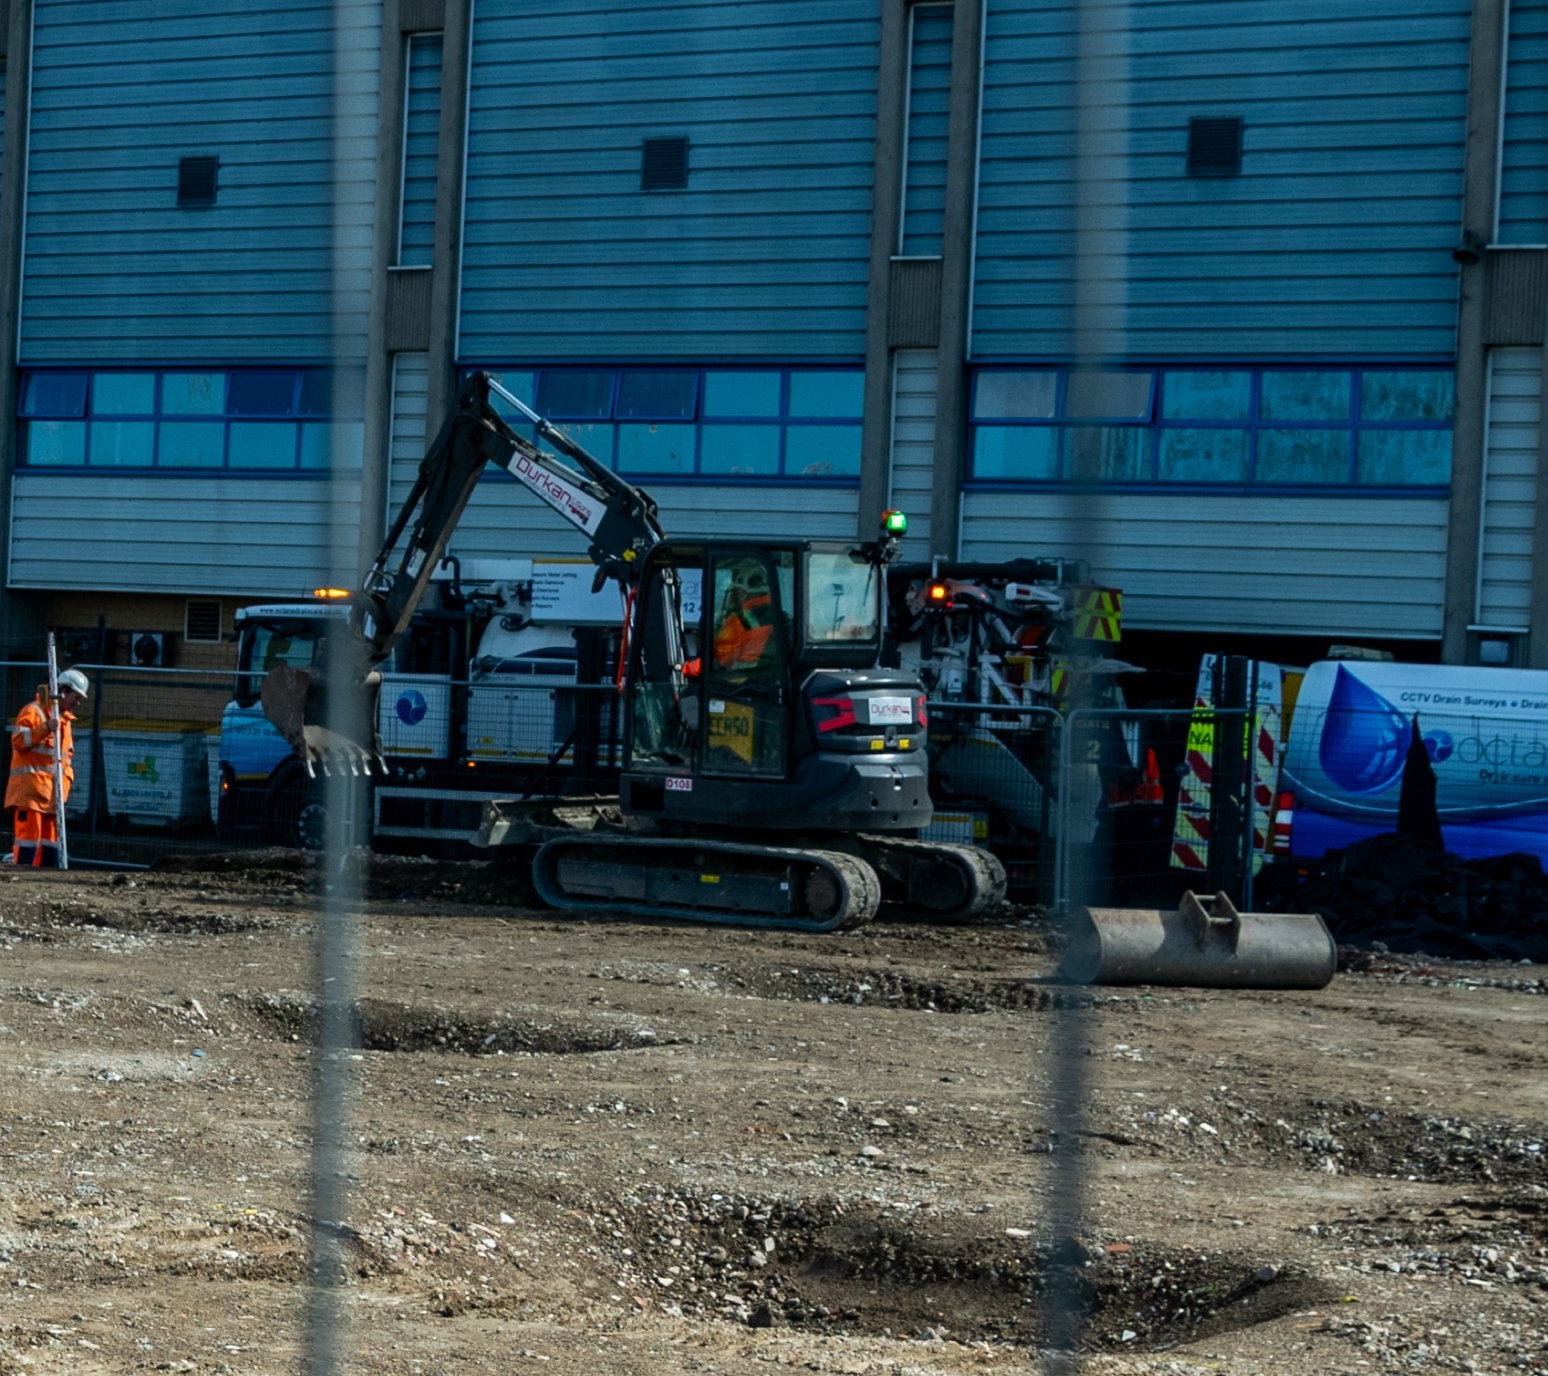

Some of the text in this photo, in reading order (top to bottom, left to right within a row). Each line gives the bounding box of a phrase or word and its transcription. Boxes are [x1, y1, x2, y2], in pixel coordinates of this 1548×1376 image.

[516, 455, 572, 506] Durkan
[1400, 691, 1432, 703] CCTV
[1432, 693, 1462, 705] Drain
[1465, 695, 1507, 708] Surveys
[1087, 739, 1101, 760] 2
